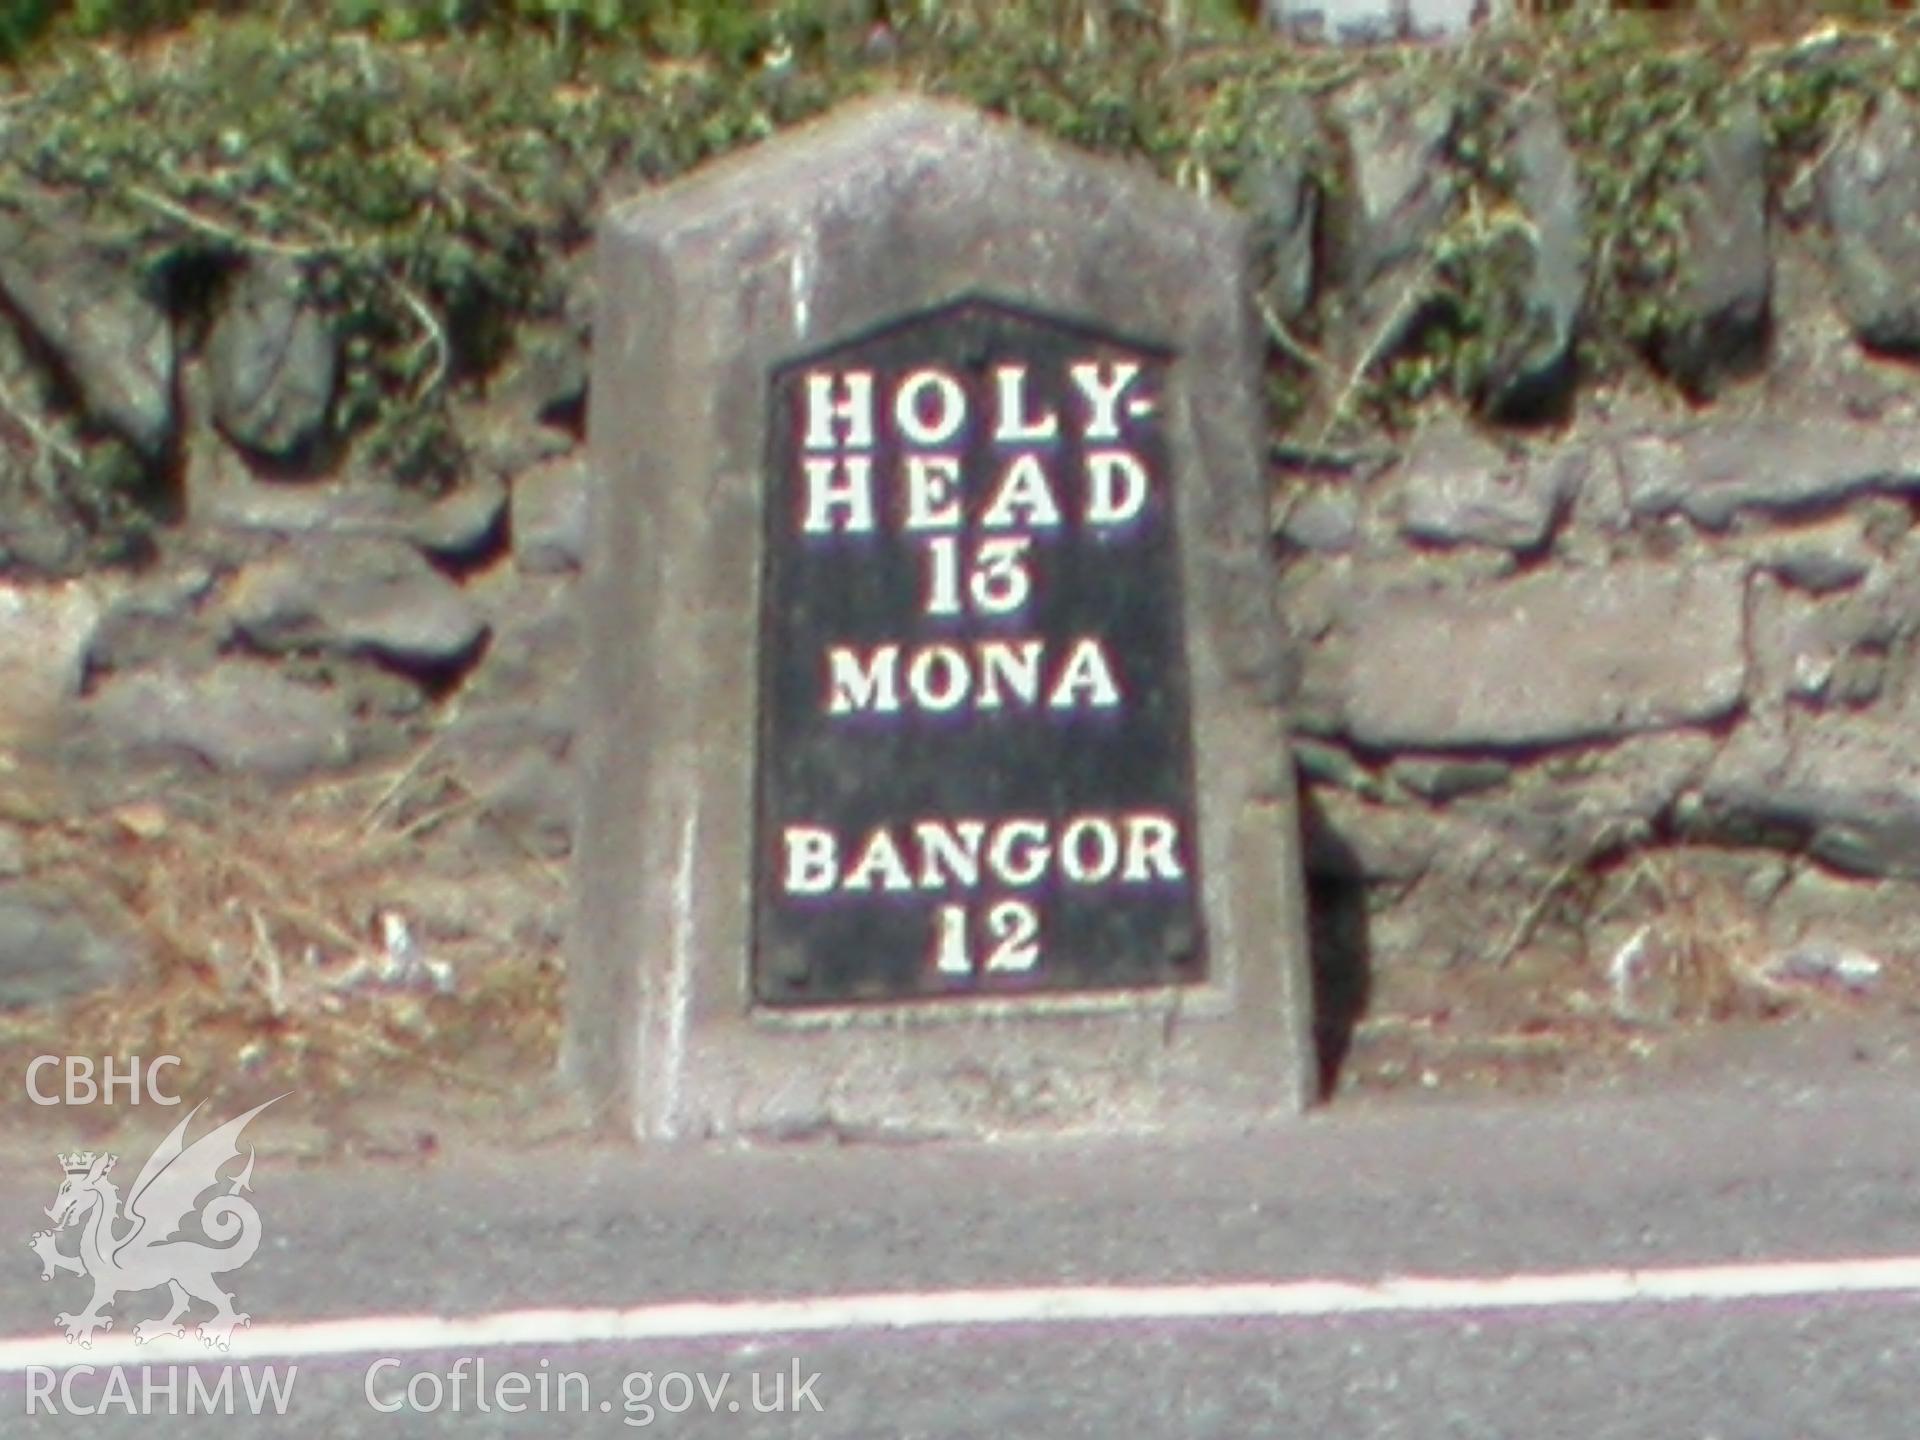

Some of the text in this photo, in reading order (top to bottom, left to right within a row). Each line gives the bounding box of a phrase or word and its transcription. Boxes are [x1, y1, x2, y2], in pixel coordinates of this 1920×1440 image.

[804, 363, 1154, 449] HOLY-
[803, 451, 1149, 532] HEAD
[926, 537, 1032, 615] 13
[827, 638, 1120, 714] MONA
[783, 816, 1183, 894] BANGOR
[936, 901, 1040, 973] 12
